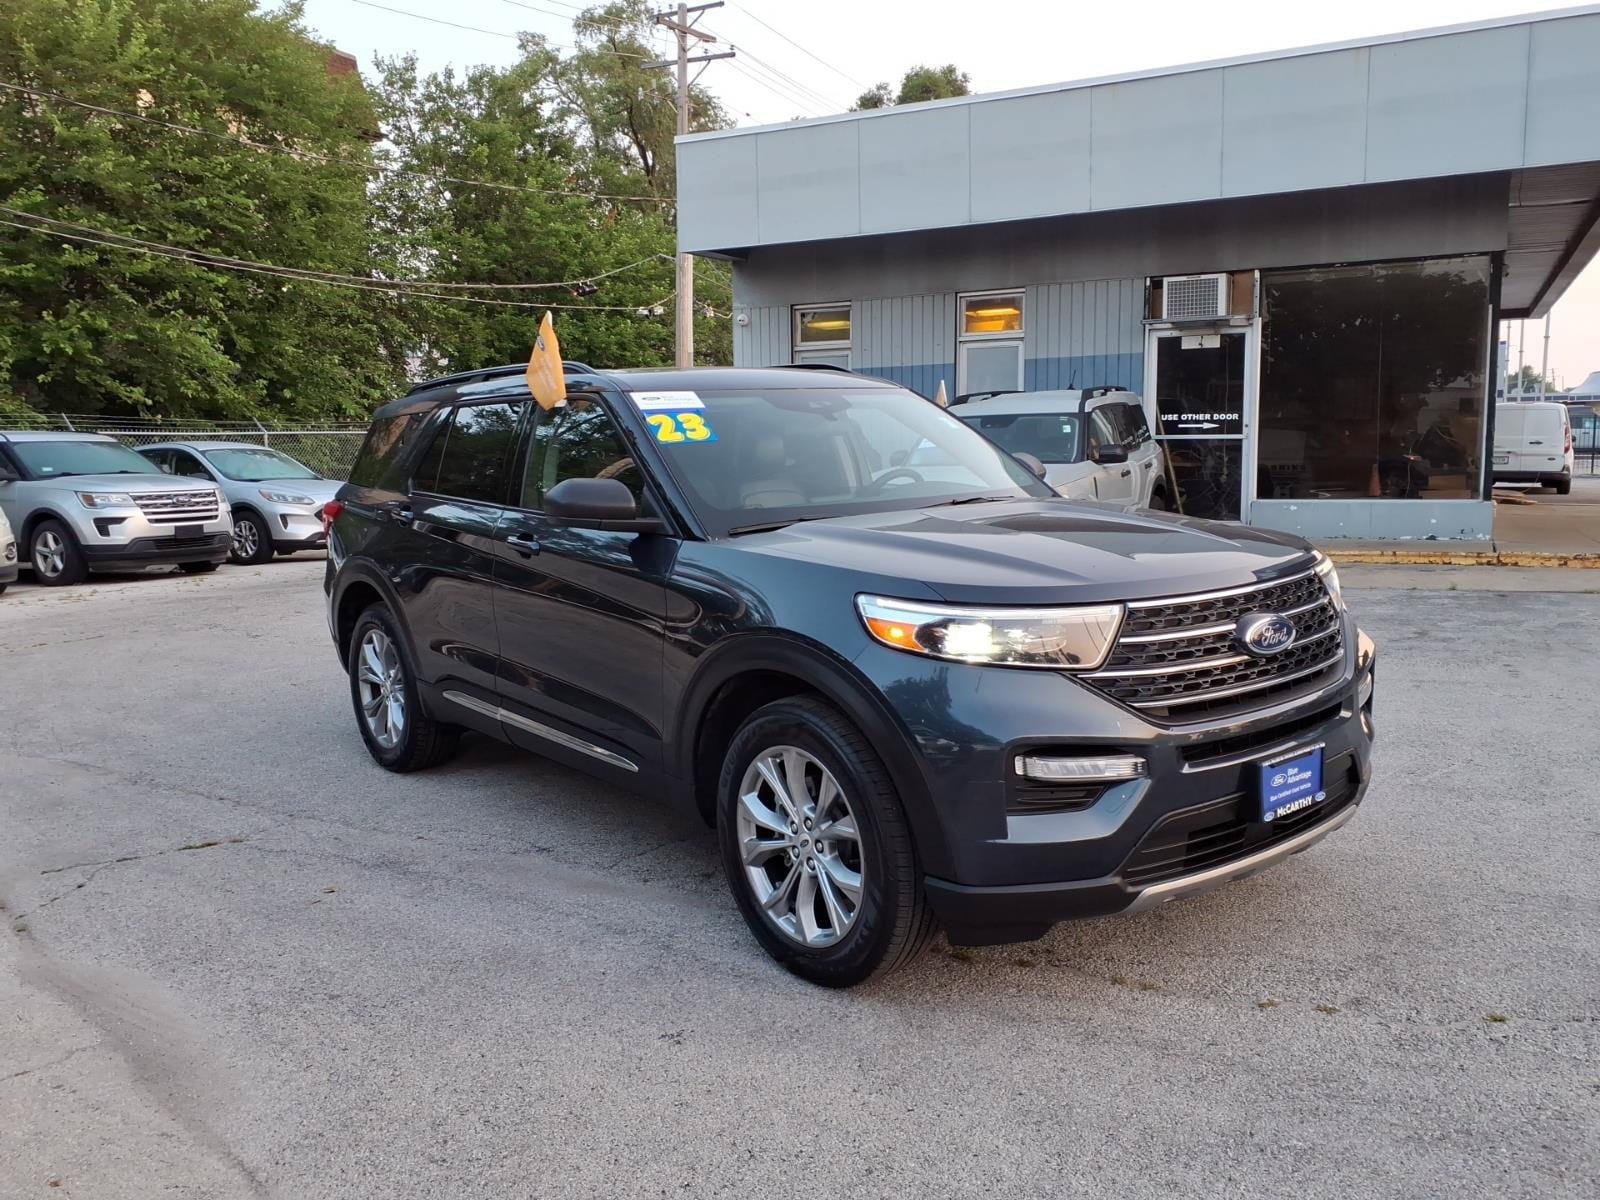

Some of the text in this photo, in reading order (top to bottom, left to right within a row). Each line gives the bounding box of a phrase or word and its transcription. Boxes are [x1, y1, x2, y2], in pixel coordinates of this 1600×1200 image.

[646, 413, 711, 442] 23
[1180, 413, 1211, 421] OTHER
[1213, 413, 1239, 421] DOOR
[1261, 624, 1289, 647] Ford
[1277, 795, 1312, 817] McCARTHY
